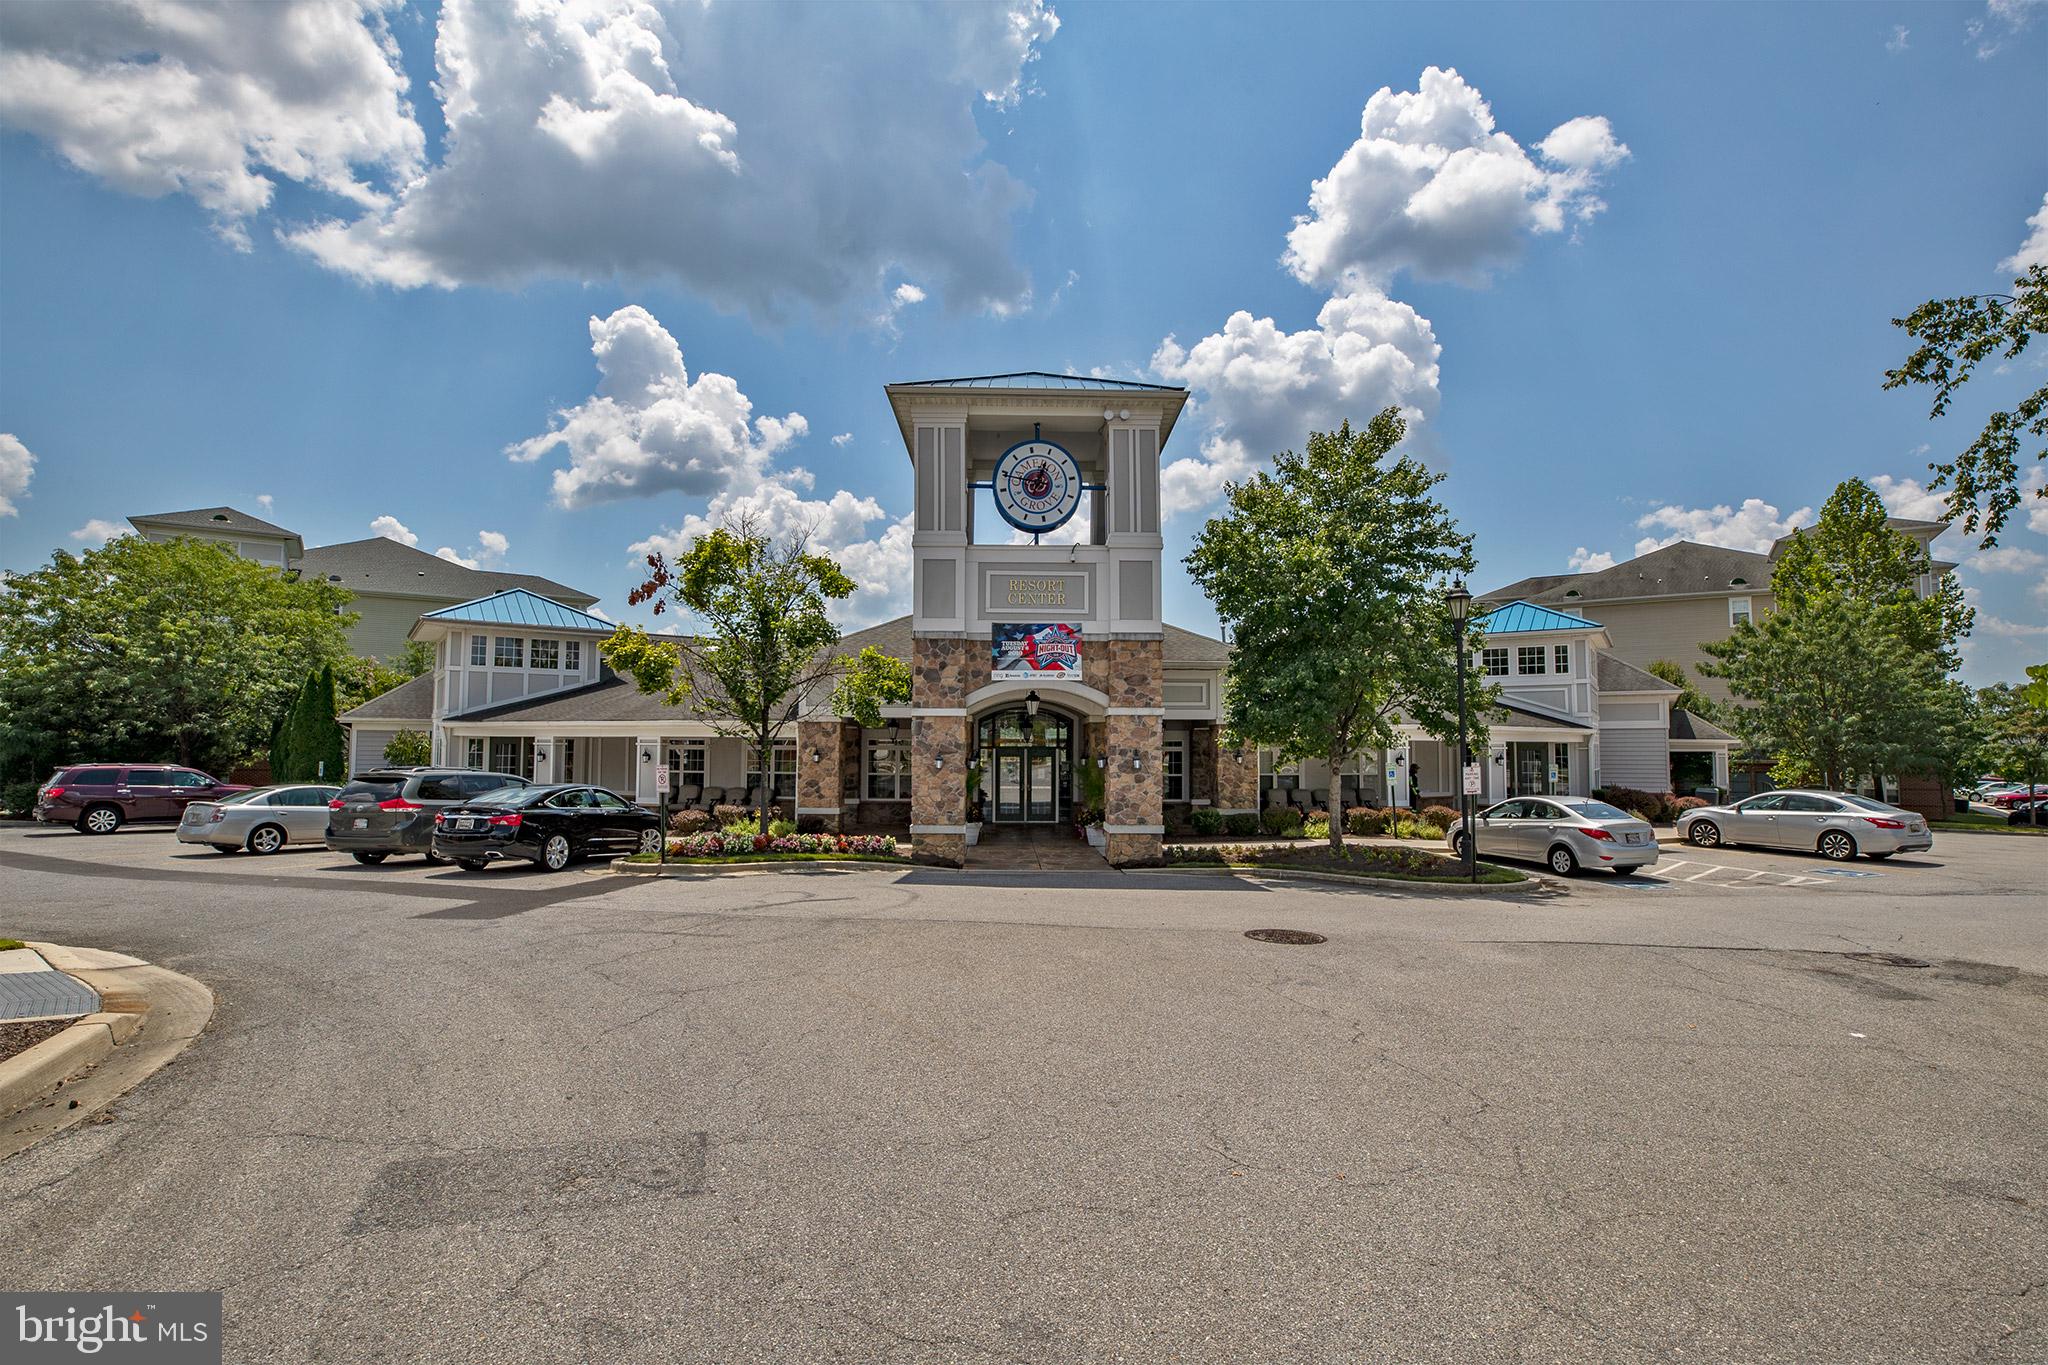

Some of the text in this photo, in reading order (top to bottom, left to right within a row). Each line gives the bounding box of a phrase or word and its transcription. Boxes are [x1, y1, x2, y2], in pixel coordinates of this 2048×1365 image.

[1020, 492, 1059, 511] GROVE
[1009, 579, 1066, 592] RESORT
[1007, 592, 1066, 606] CENTER
[1038, 644, 1059, 653] NIGHT
[1060, 644, 1074, 654] OUT
